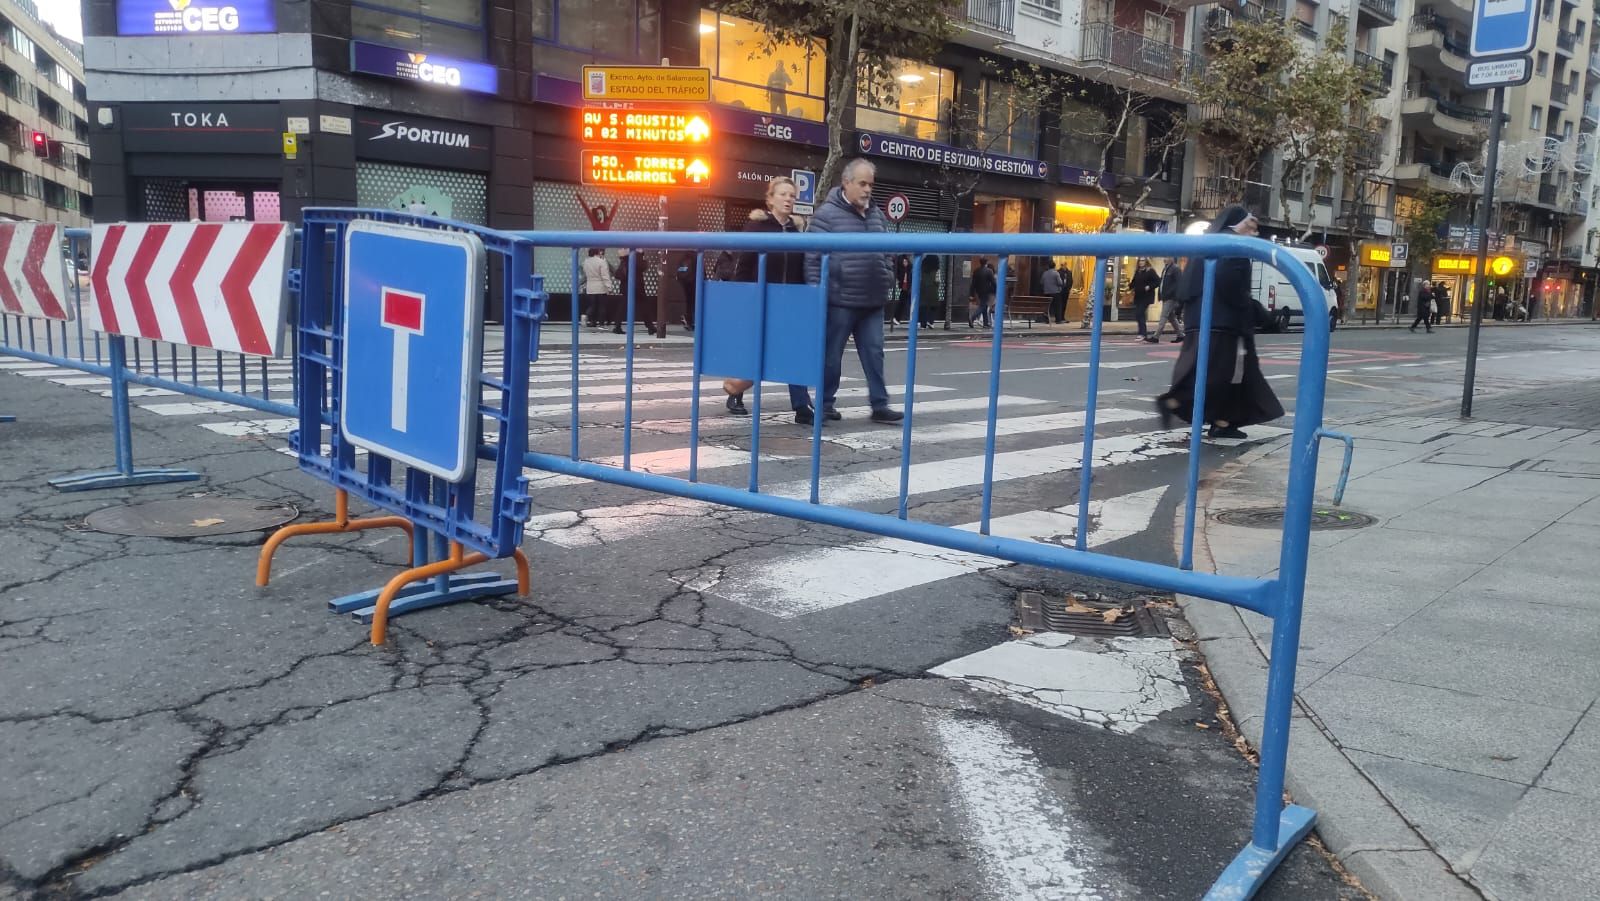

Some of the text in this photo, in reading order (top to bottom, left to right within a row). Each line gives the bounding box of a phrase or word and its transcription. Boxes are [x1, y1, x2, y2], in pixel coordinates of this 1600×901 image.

[183, 7, 239, 31] CEG
[419, 62, 461, 86] CEG
[637, 74, 653, 82] Ayto.
[610, 85, 704, 95] ESTADO DEL TRÁFICO
[171, 112, 229, 127] TOKA
[584, 113, 601, 124] AV
[368, 121, 470, 148] SPORTIUM
[584, 127, 685, 142] A 02 MINUTOS
[767, 124, 793, 140] CEG
[592, 156, 685, 170] PSO. TORRES
[881, 140, 1034, 176] CENTRO DE ESTUDIOS GESTIÓN
[592, 169, 677, 184] VILLARROEL
[737, 171, 762, 181] SALÓN
[796, 174, 810, 200] P
[890, 202, 904, 213] 30
